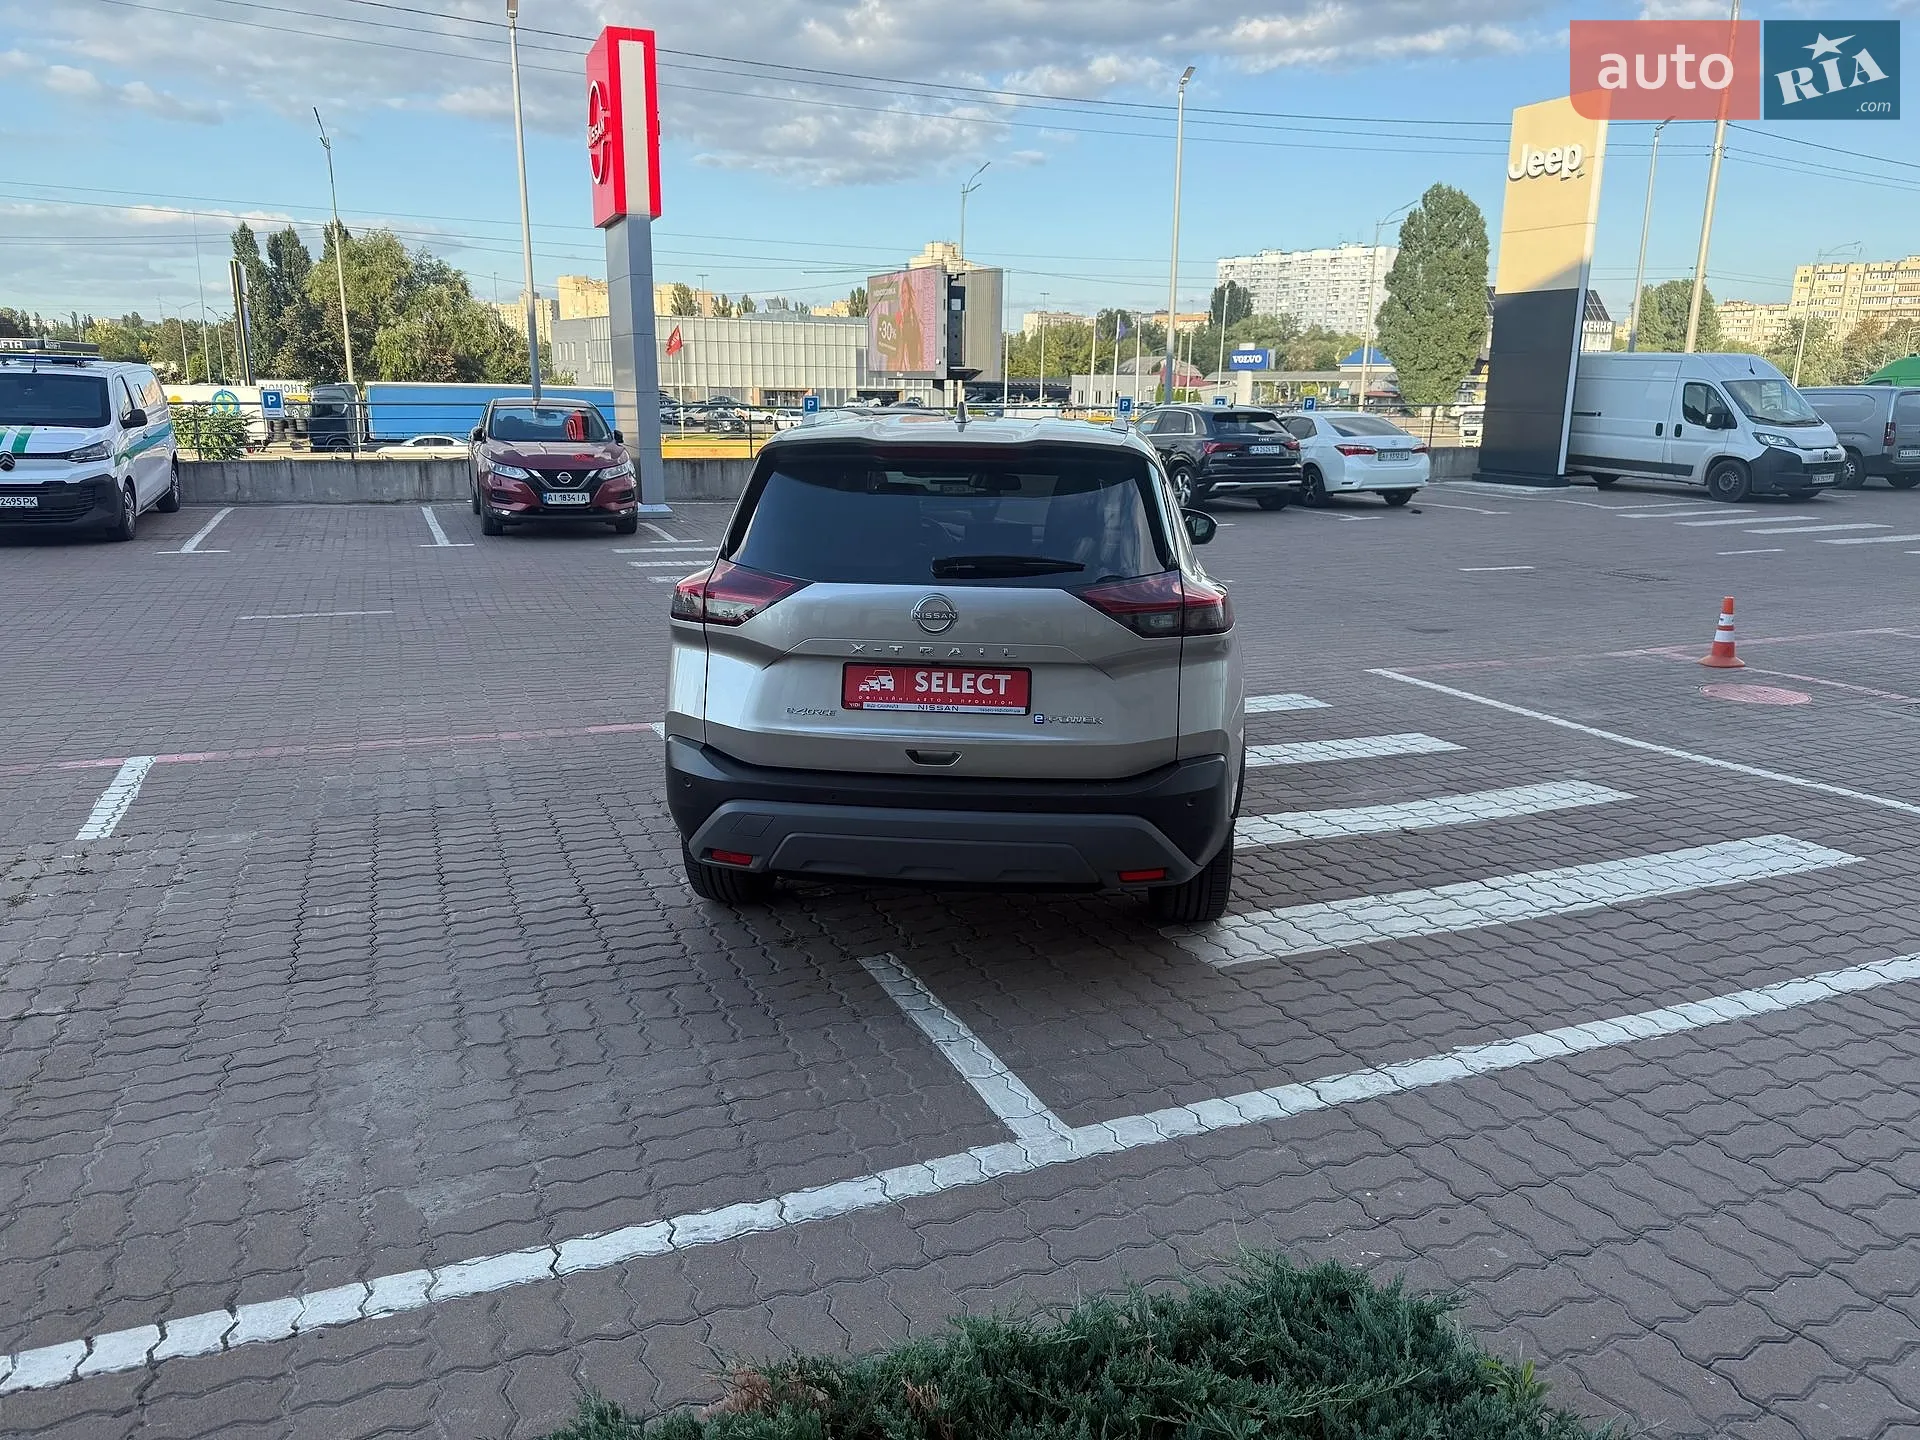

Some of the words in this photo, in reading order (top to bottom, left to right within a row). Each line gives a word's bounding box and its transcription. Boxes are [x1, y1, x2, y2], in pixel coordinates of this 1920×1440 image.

[1507, 143, 1583, 181] Jeep
[1232, 354, 1263, 364] VOLVO
[267, 394, 277, 406] P
[807, 400, 815, 410] P
[1121, 400, 1129, 410] P
[913, 611, 957, 620] NISSAN
[850, 643, 1018, 658] X-TRAIL
[914, 671, 1013, 695] SELECT
[917, 704, 960, 712] NISSAN
